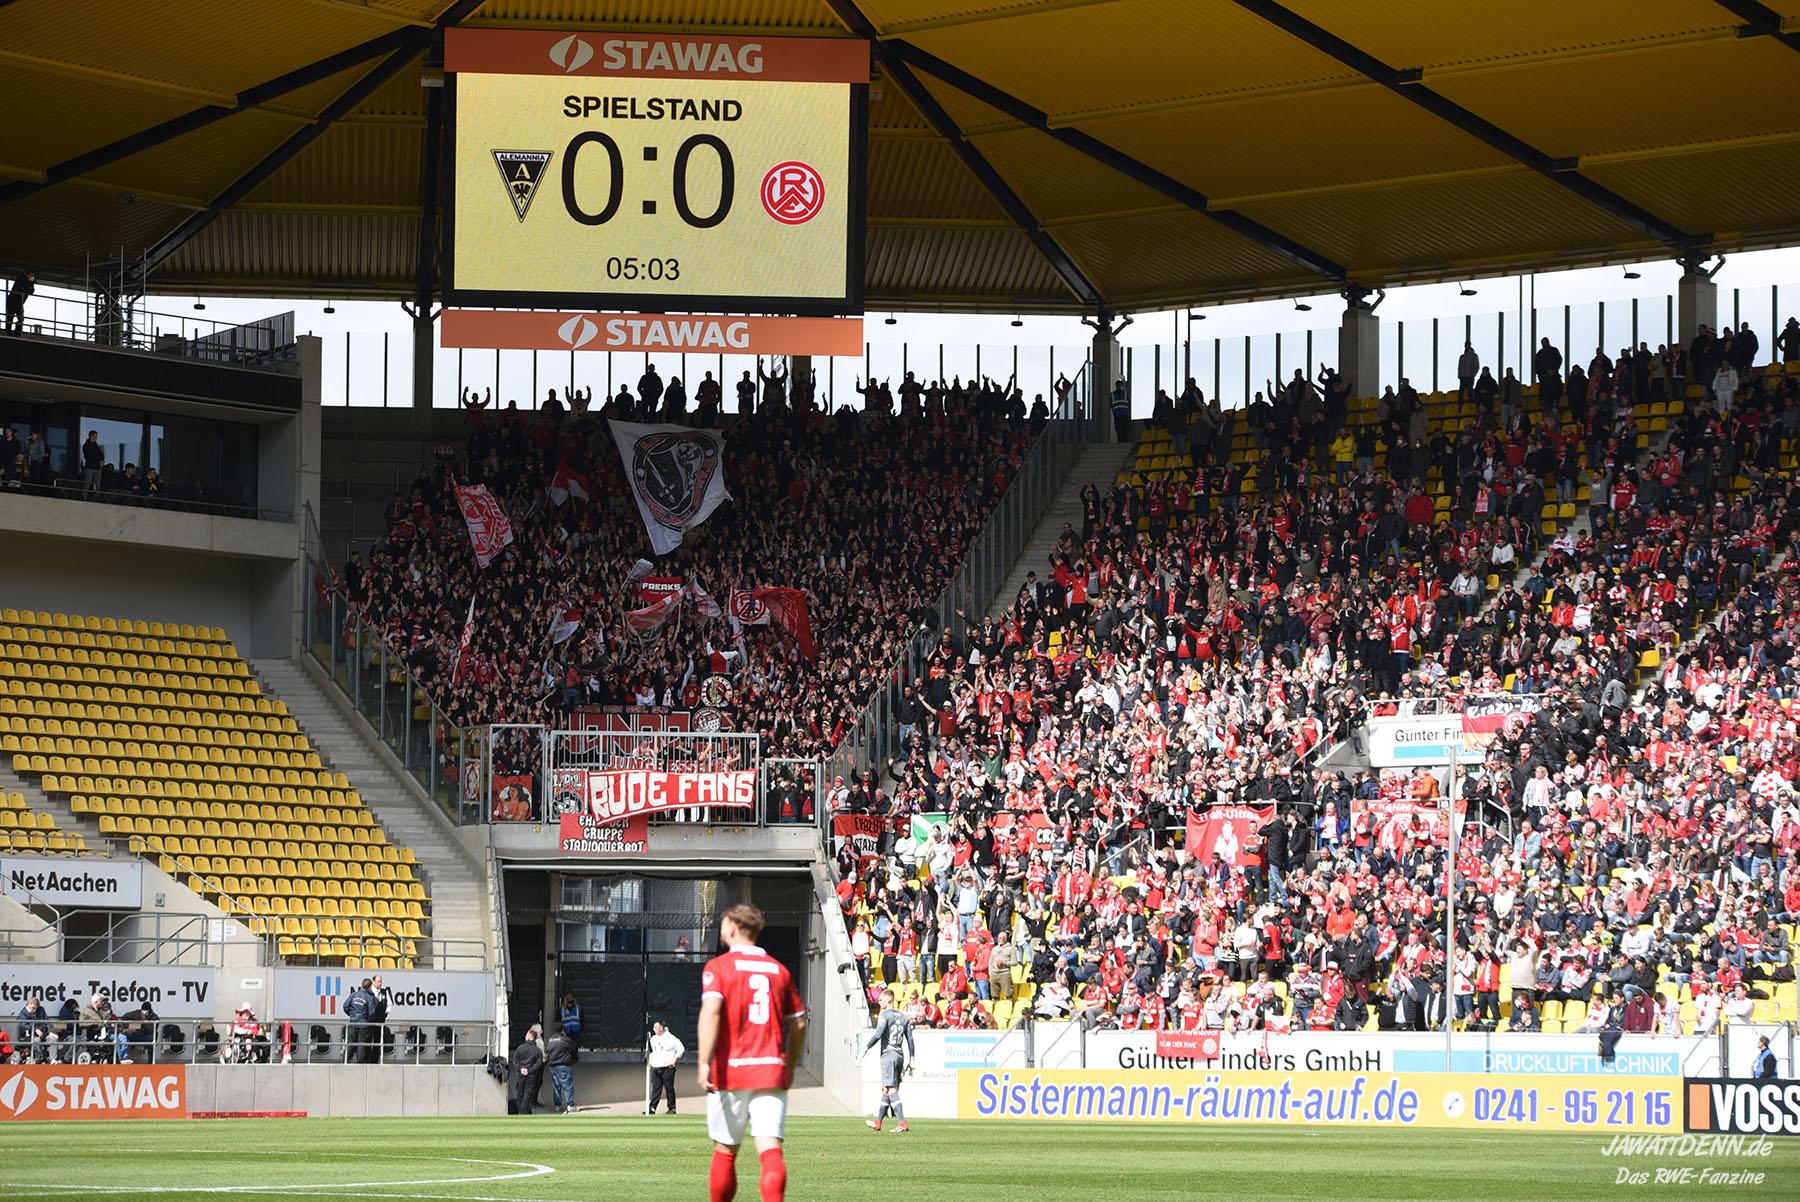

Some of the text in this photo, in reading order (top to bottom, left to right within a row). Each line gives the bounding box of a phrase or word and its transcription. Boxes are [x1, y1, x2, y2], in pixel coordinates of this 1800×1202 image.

[602, 39, 764, 73] STAWAG
[563, 95, 743, 121] SPIELSTAND
[561, 131, 735, 228] 0:0
[606, 257, 680, 280] 05:03
[606, 320, 750, 348] STAWAG
[642, 583, 681, 591] FREAKS
[1395, 728, 1438, 742] Günter
[589, 772, 756, 820] RUDE FANS
[584, 827, 623, 840] GRUPPE
[11, 870, 117, 892] NetAachen
[88, 981, 161, 1002] Telefon
[182, 981, 208, 1002] TV
[748, 974, 770, 1024] 3
[1305, 1048, 1382, 1072] GmbH
[45, 1075, 179, 1109] STAWAG
[977, 1073, 1418, 1122] Sistermann-räumt-auf.de
[1473, 1088, 1537, 1122] 0241
[1564, 1090, 1598, 1123] 95
[1607, 1090, 1634, 1124] 21
[1644, 1091, 1671, 1125] 15
[1711, 1084, 1800, 1133] VOSS
